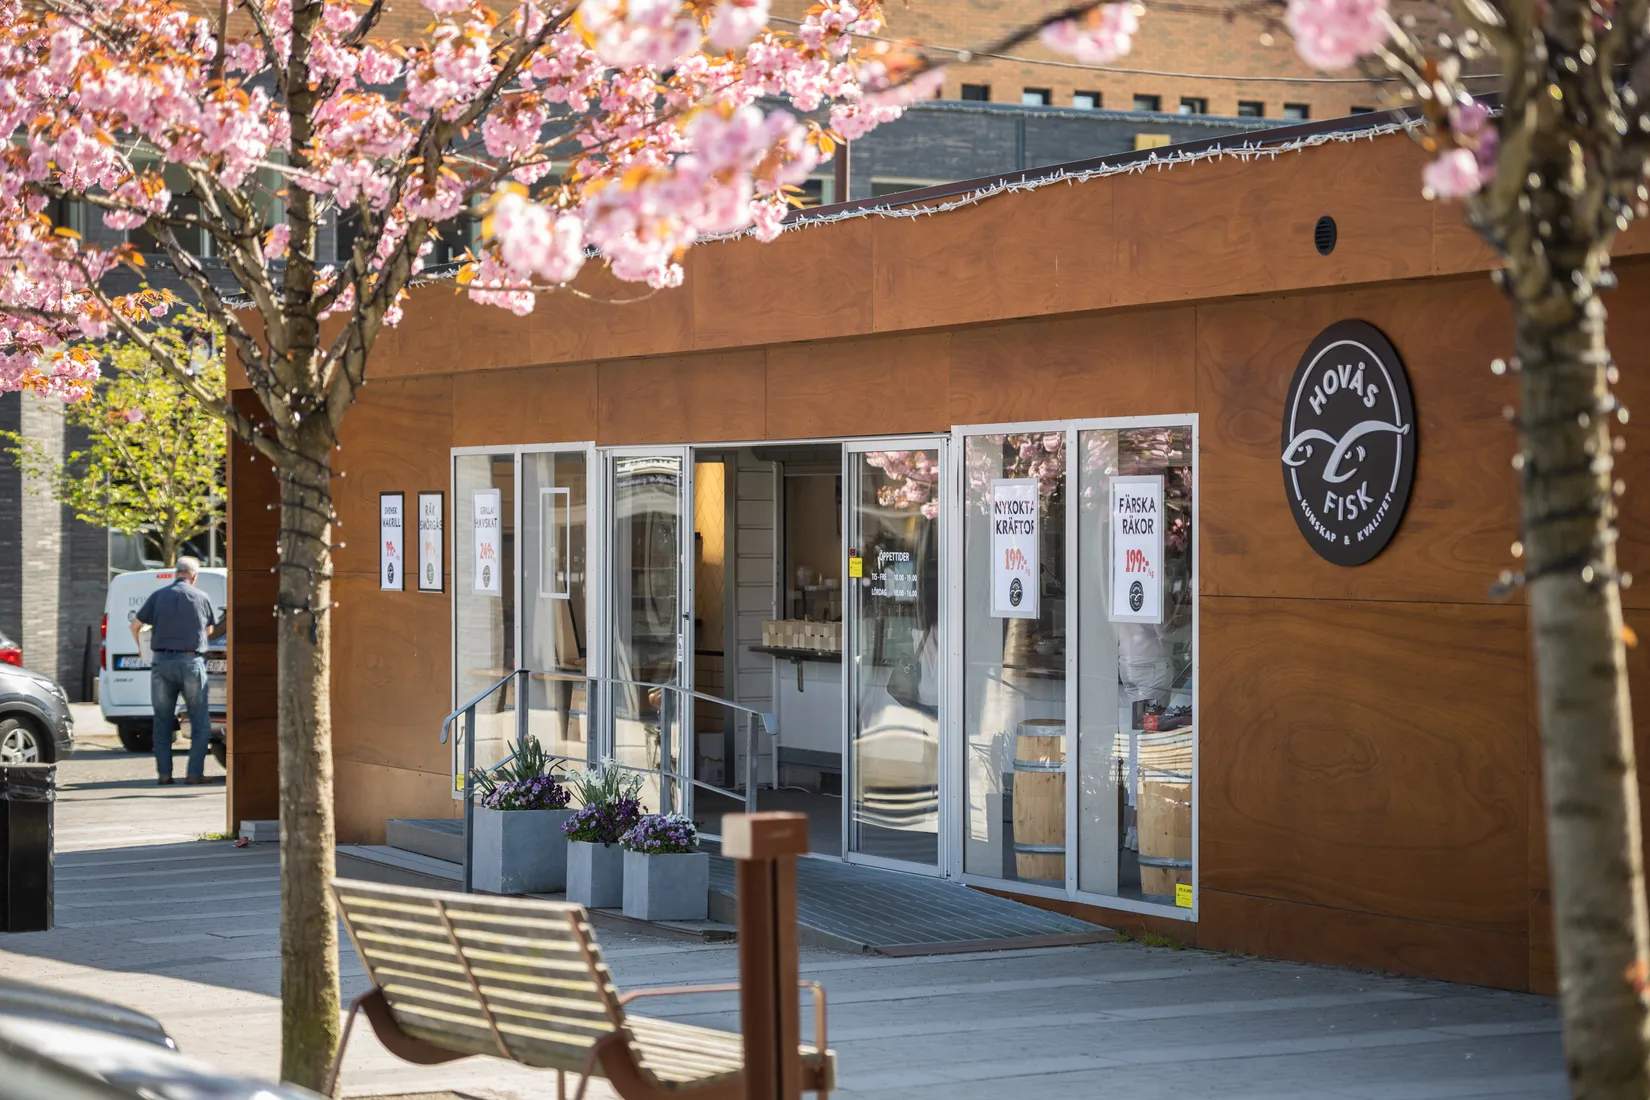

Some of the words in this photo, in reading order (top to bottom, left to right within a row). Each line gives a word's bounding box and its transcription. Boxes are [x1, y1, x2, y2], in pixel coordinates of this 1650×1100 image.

[1308, 361, 1380, 416] HOVÅS
[1118, 494, 1157, 514] FÄRSKA
[1323, 480, 1375, 521] FISK
[1122, 516, 1154, 535] RÄKOR
[1300, 499, 1337, 542] KUNSKAP
[1343, 535, 1351, 546] &
[1356, 492, 1393, 542] KVALITET
[879, 550, 910, 561] ÖPPETTIDER
